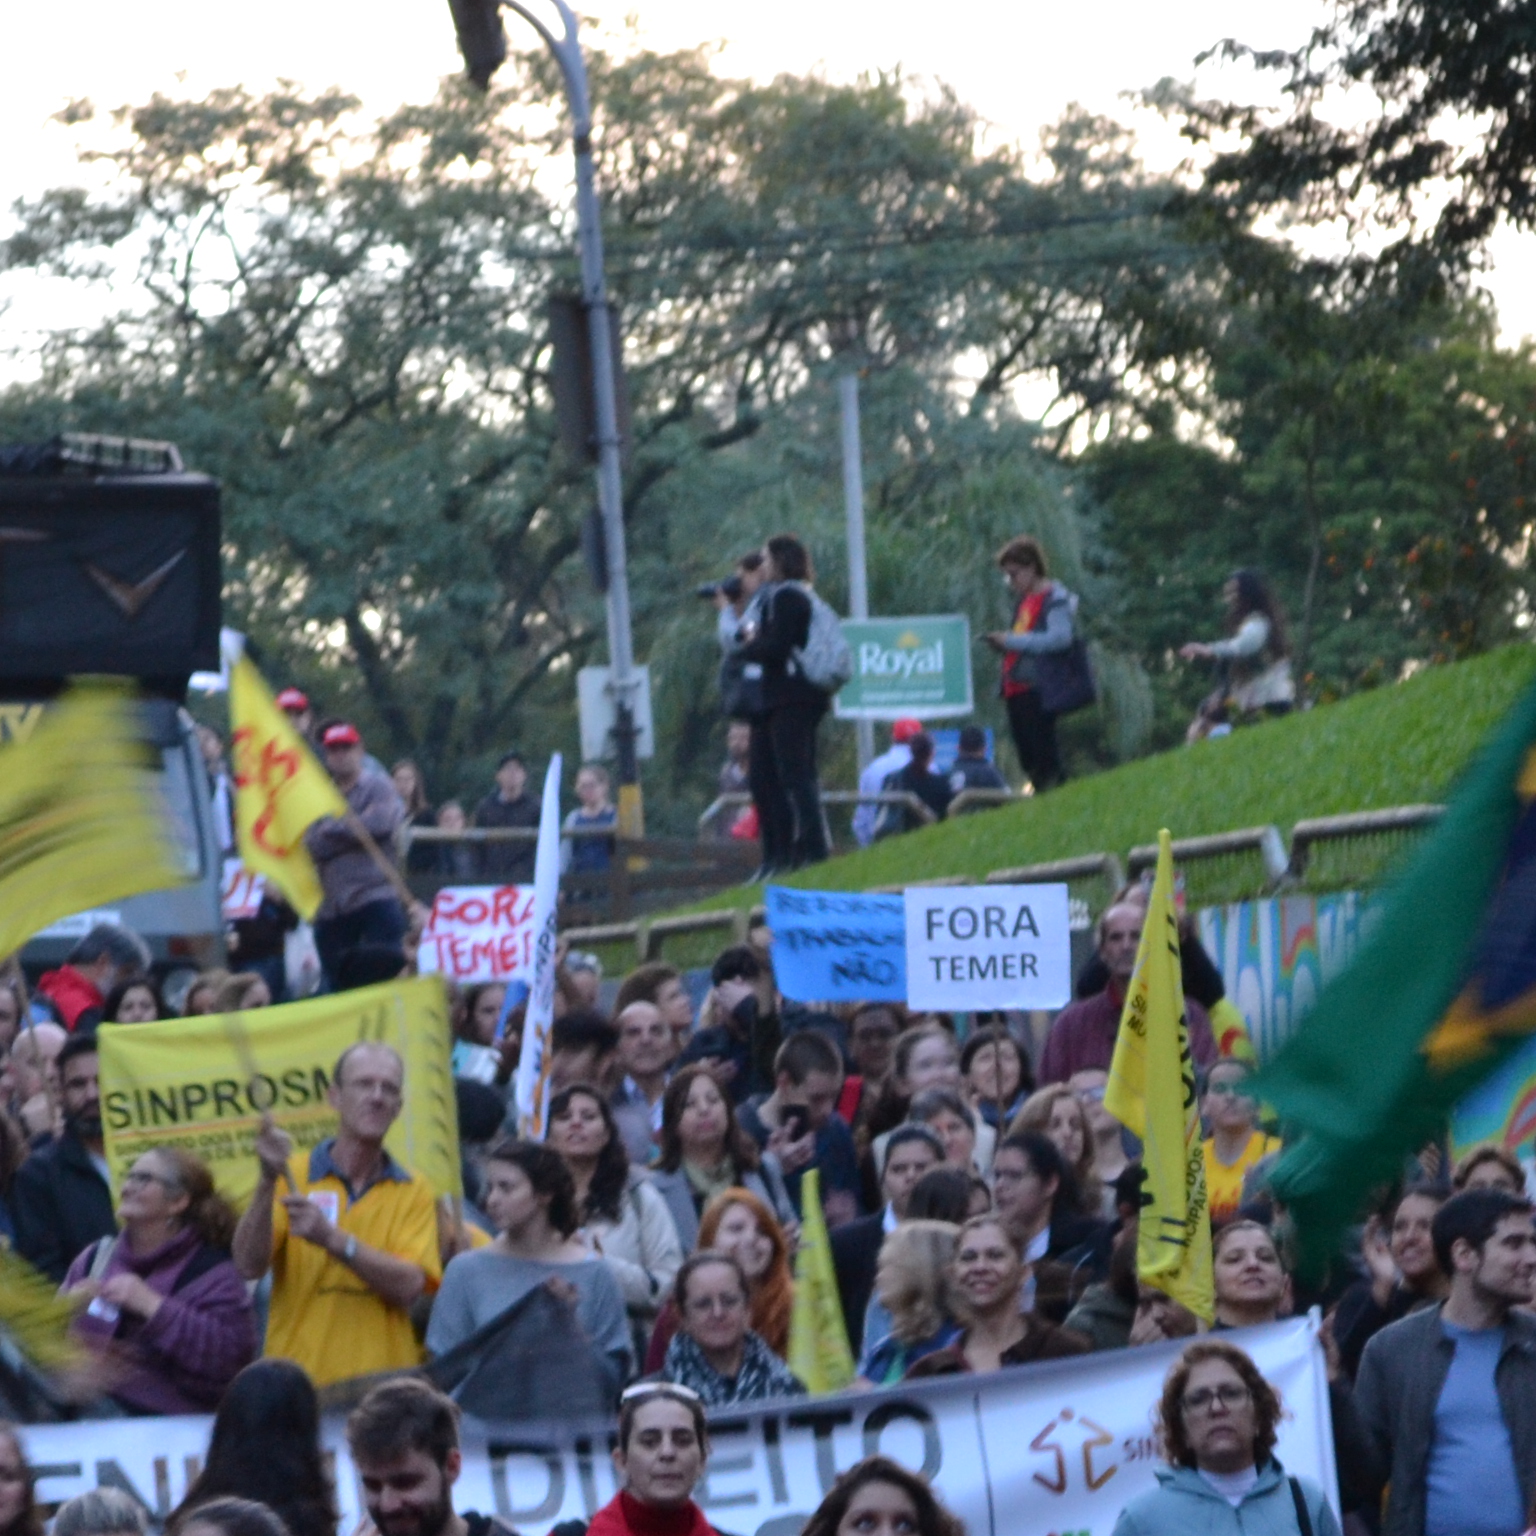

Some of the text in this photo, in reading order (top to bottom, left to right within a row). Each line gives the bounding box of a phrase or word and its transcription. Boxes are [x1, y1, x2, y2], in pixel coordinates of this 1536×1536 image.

[860, 639, 944, 680] Royal
[926, 905, 1040, 941] FORA
[929, 953, 1039, 981] TEMER
